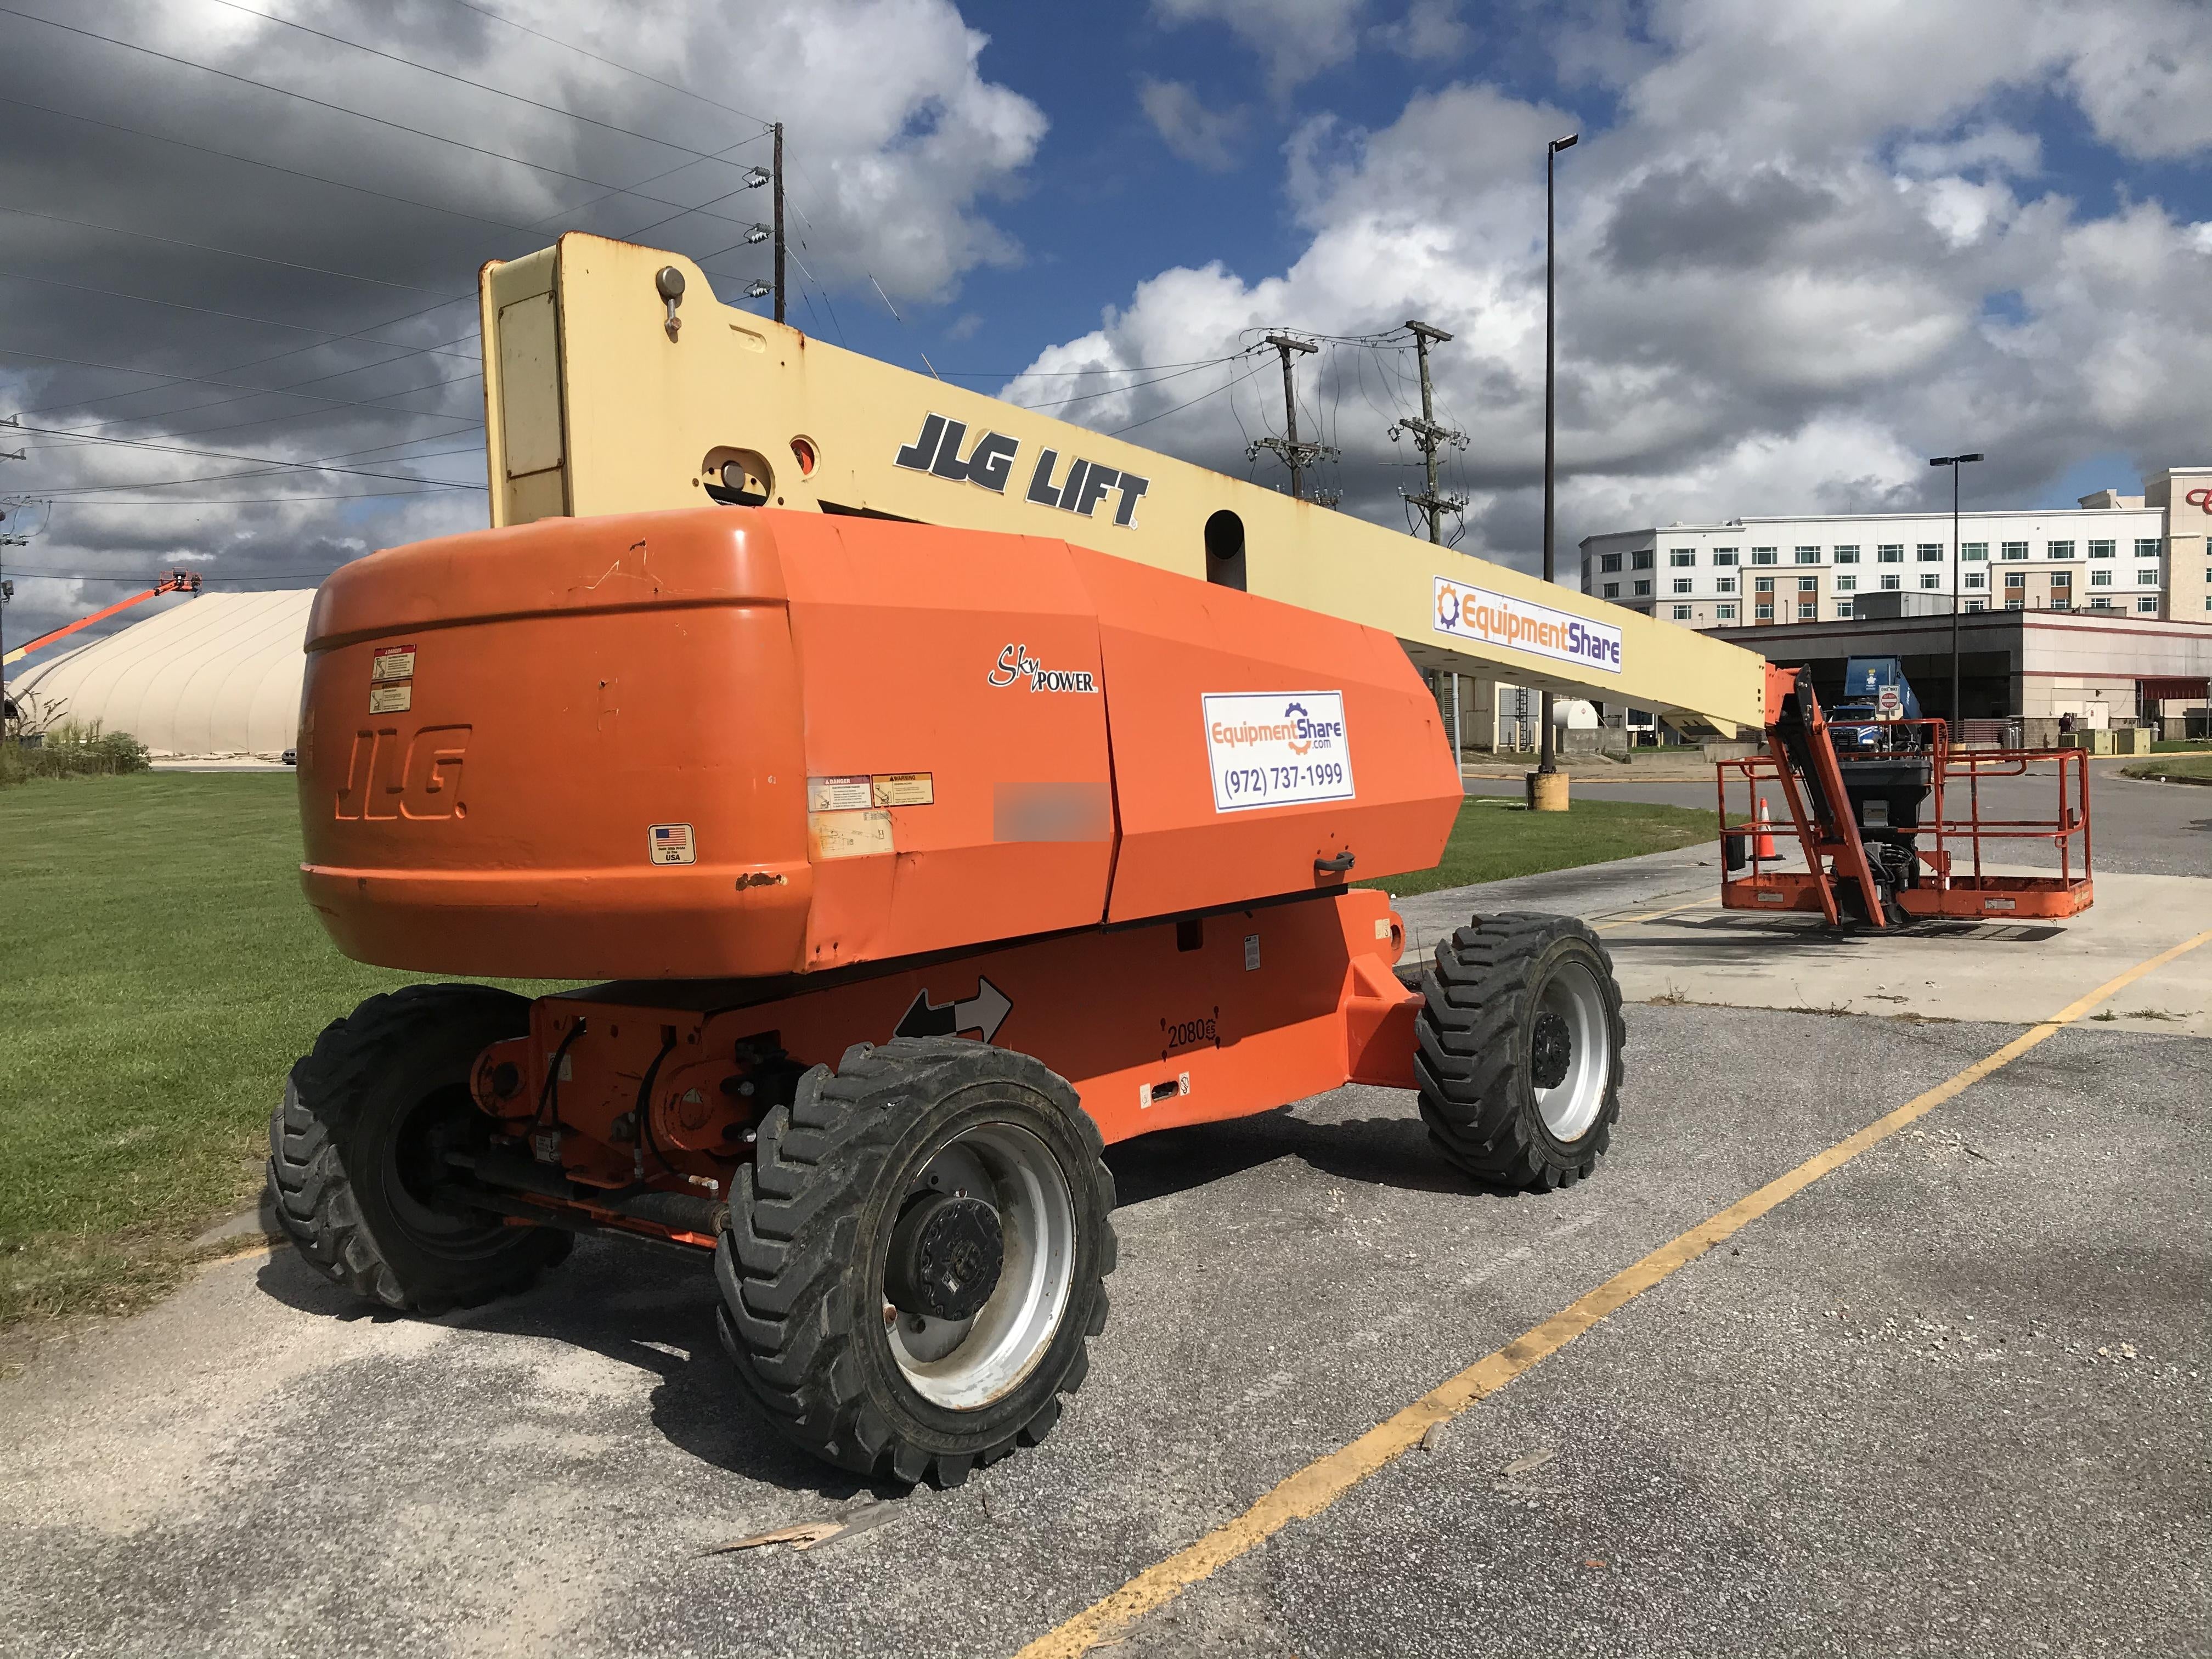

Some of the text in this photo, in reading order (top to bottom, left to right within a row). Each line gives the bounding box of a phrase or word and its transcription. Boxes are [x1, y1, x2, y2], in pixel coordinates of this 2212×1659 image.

[893, 411, 1150, 527] JLG LIFT
[1462, 594, 1620, 664] EquipmentShare
[988, 644, 1094, 692] Sky POWER
[1211, 719, 1342, 748] EquipmentShare
[1312, 739, 1331, 749] .com
[1224, 763, 1342, 800] (972) 737-1999
[1167, 1019, 1205, 1048] 2080
